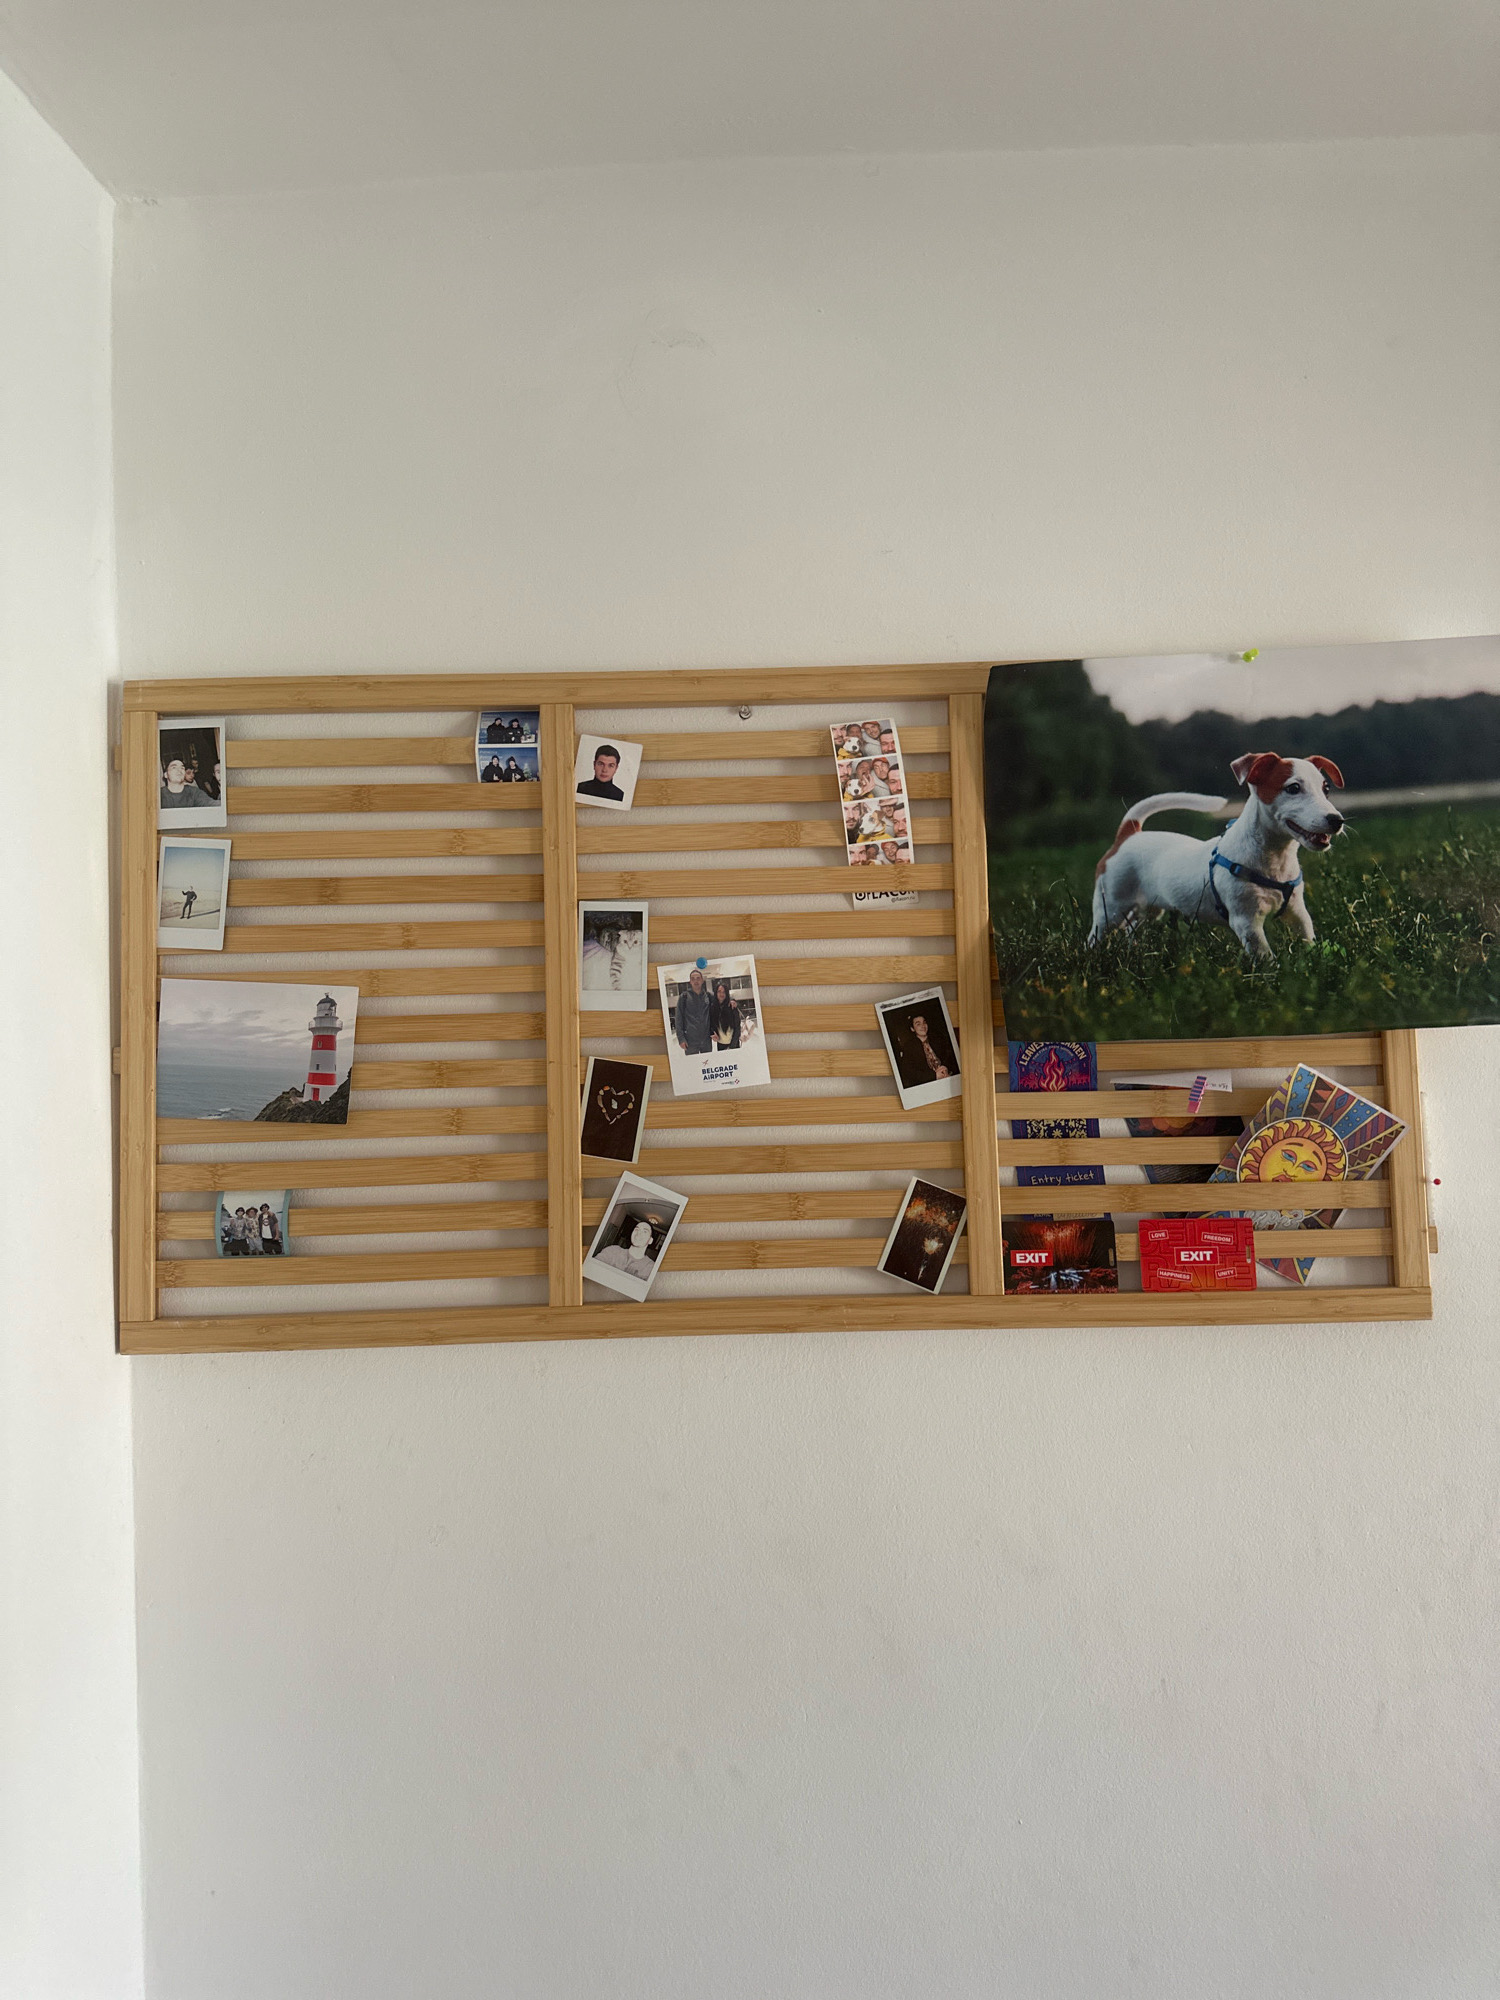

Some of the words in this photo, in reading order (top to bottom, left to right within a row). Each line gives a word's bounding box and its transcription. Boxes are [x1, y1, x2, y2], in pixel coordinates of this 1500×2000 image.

[702, 1064, 738, 1074] BELGRADE
[1031, 1173, 1062, 1186] Entry
[1065, 1169, 1095, 1183] ticket
[1203, 1234, 1231, 1243] FREEDOM
[1015, 1252, 1049, 1264] EXIT
[1180, 1250, 1214, 1262] EXIT
[1159, 1270, 1191, 1281] HAPPINESS
[1217, 1270, 1235, 1278] UNITY
